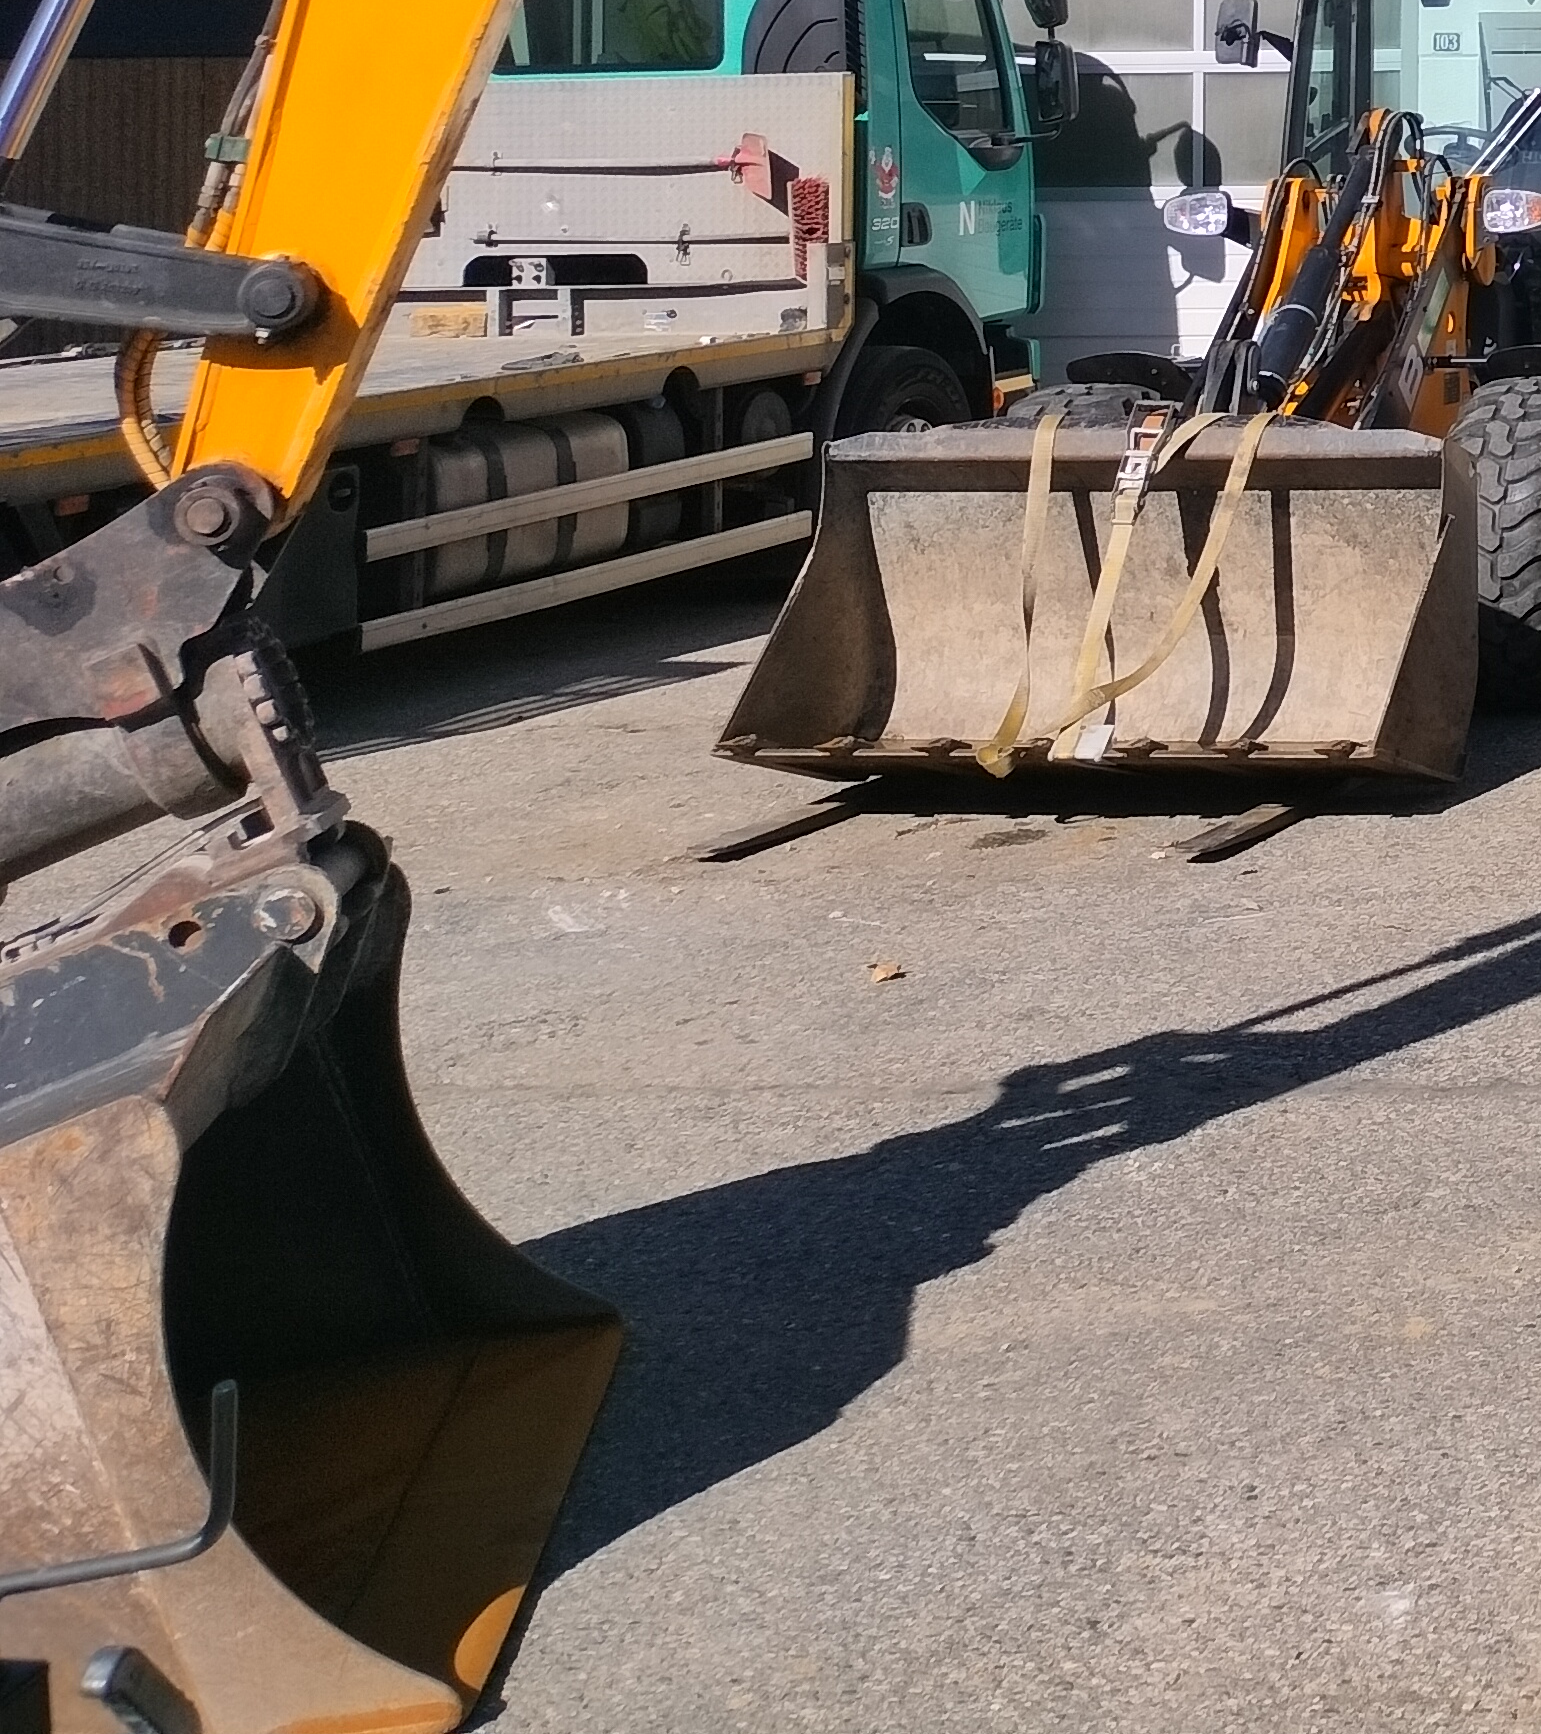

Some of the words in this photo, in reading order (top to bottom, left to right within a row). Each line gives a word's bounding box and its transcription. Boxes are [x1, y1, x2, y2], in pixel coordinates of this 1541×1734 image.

[1434, 33, 1459, 51] 103
[871, 217, 899, 231] 320
[959, 200, 976, 236] N
